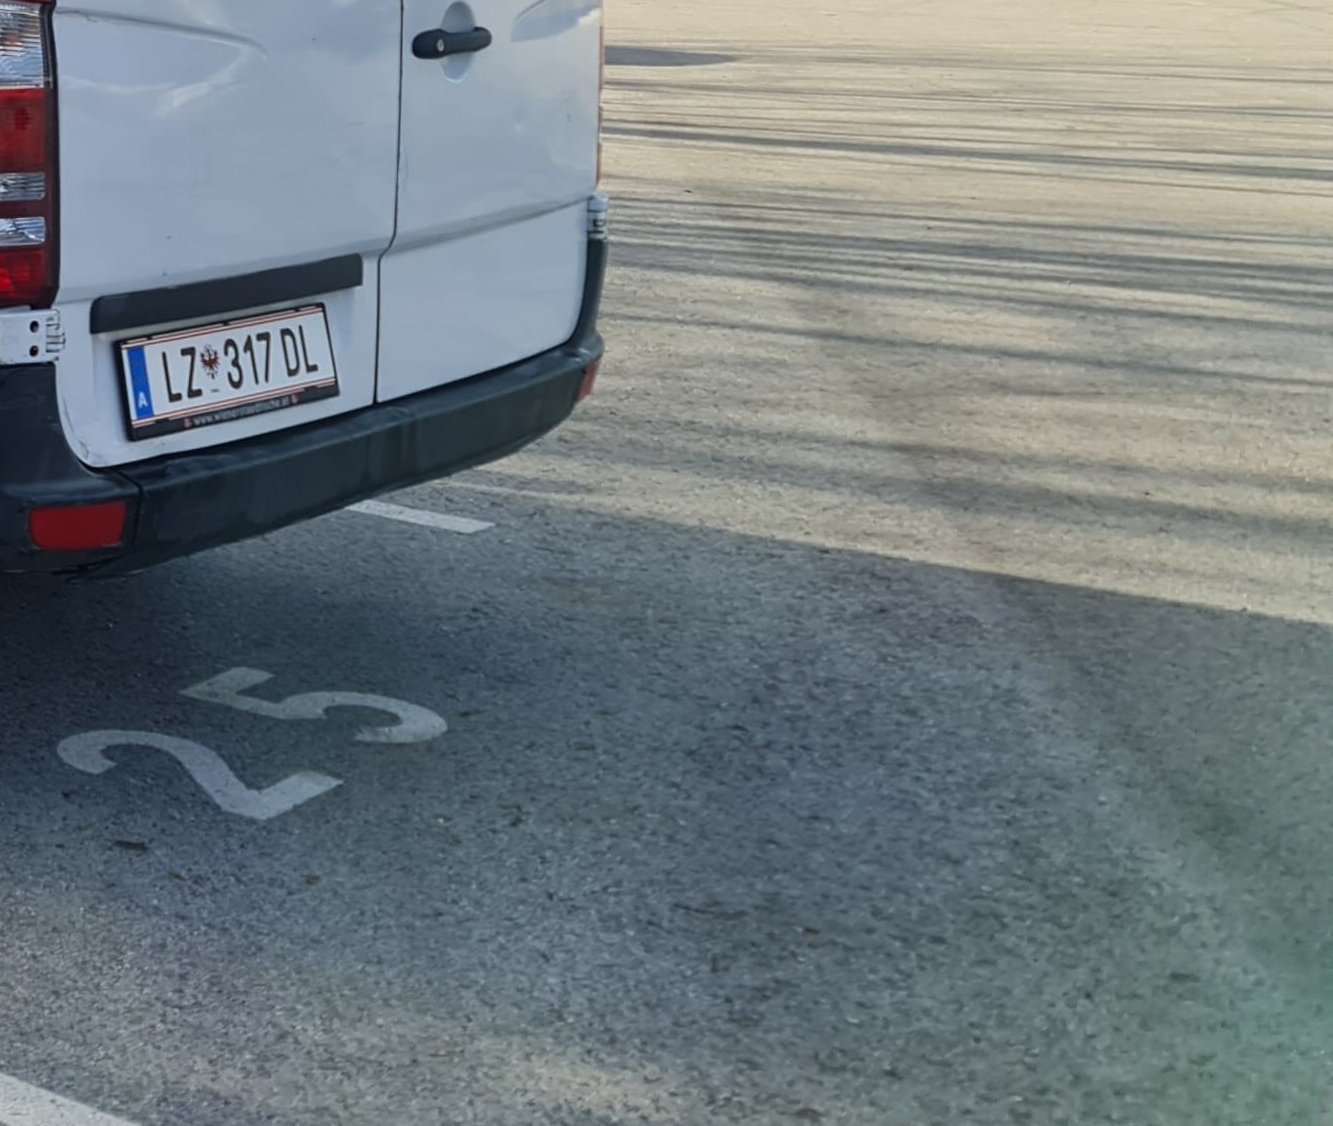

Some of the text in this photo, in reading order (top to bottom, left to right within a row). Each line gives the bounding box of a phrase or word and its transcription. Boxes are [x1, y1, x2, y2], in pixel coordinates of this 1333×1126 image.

[137, 390, 149, 409] A
[162, 324, 319, 403] LZ 317 DL
[56, 666, 449, 821] 25
